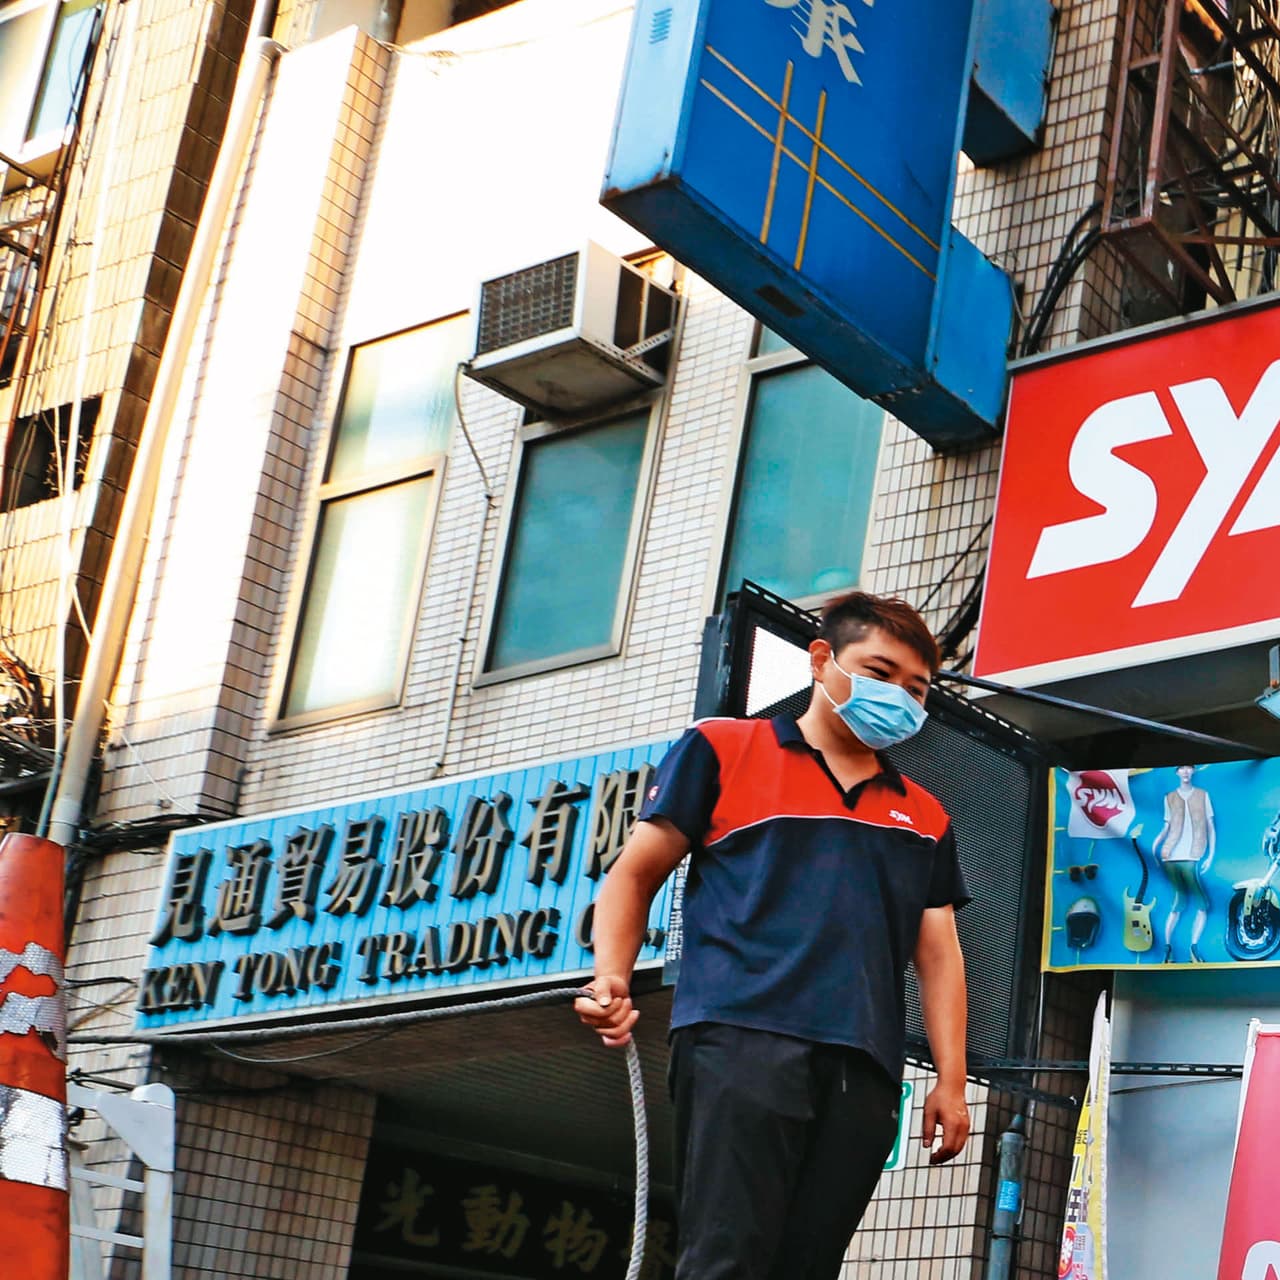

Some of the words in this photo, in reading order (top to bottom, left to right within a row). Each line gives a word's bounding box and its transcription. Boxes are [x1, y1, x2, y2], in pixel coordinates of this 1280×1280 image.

[137, 960, 223, 1015] KEN
[233, 940, 343, 999] TONG
[357, 907, 562, 984] TRADING
